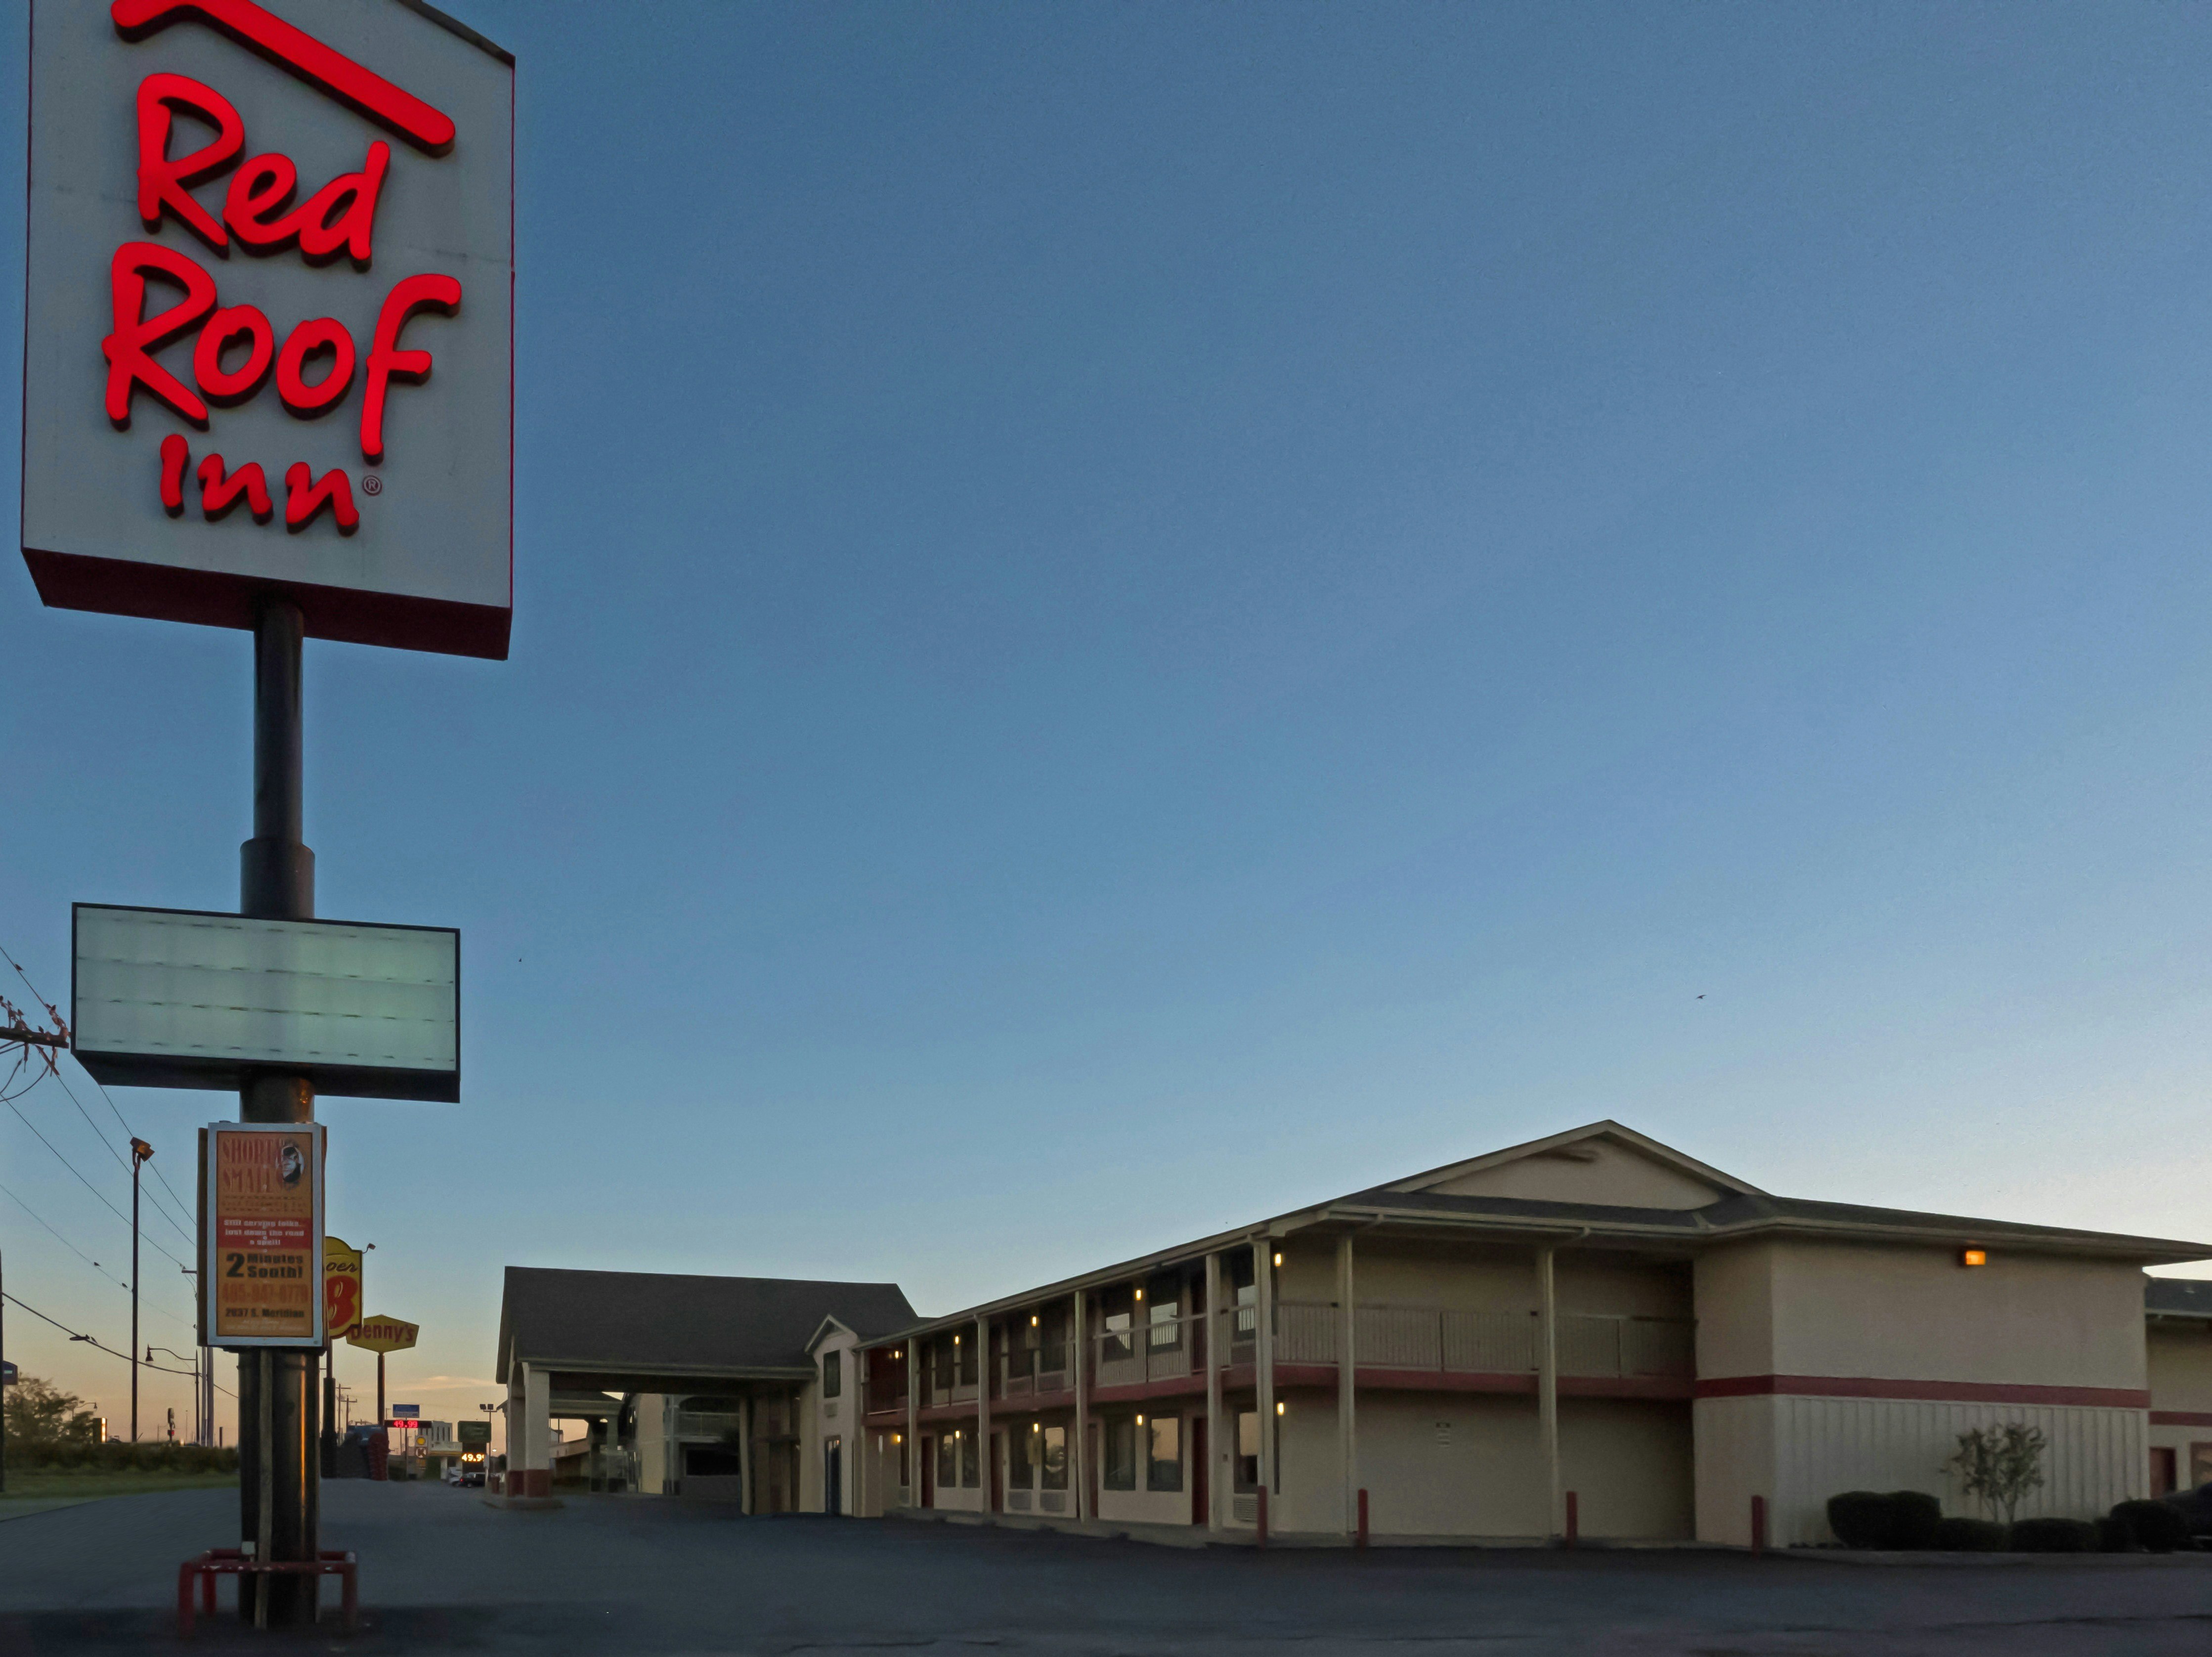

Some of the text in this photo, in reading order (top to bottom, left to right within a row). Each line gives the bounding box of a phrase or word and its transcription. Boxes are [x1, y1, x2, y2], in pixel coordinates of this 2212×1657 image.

[137, 73, 390, 262] Red
[102, 241, 461, 457] Roof
[161, 435, 359, 527] Inn
[226, 1253, 303, 1277] 2 Minutes
[248, 1265, 303, 1278] South!
[262, 1308, 304, 1318] Meridian
[350, 1324, 415, 1343] Denny's
